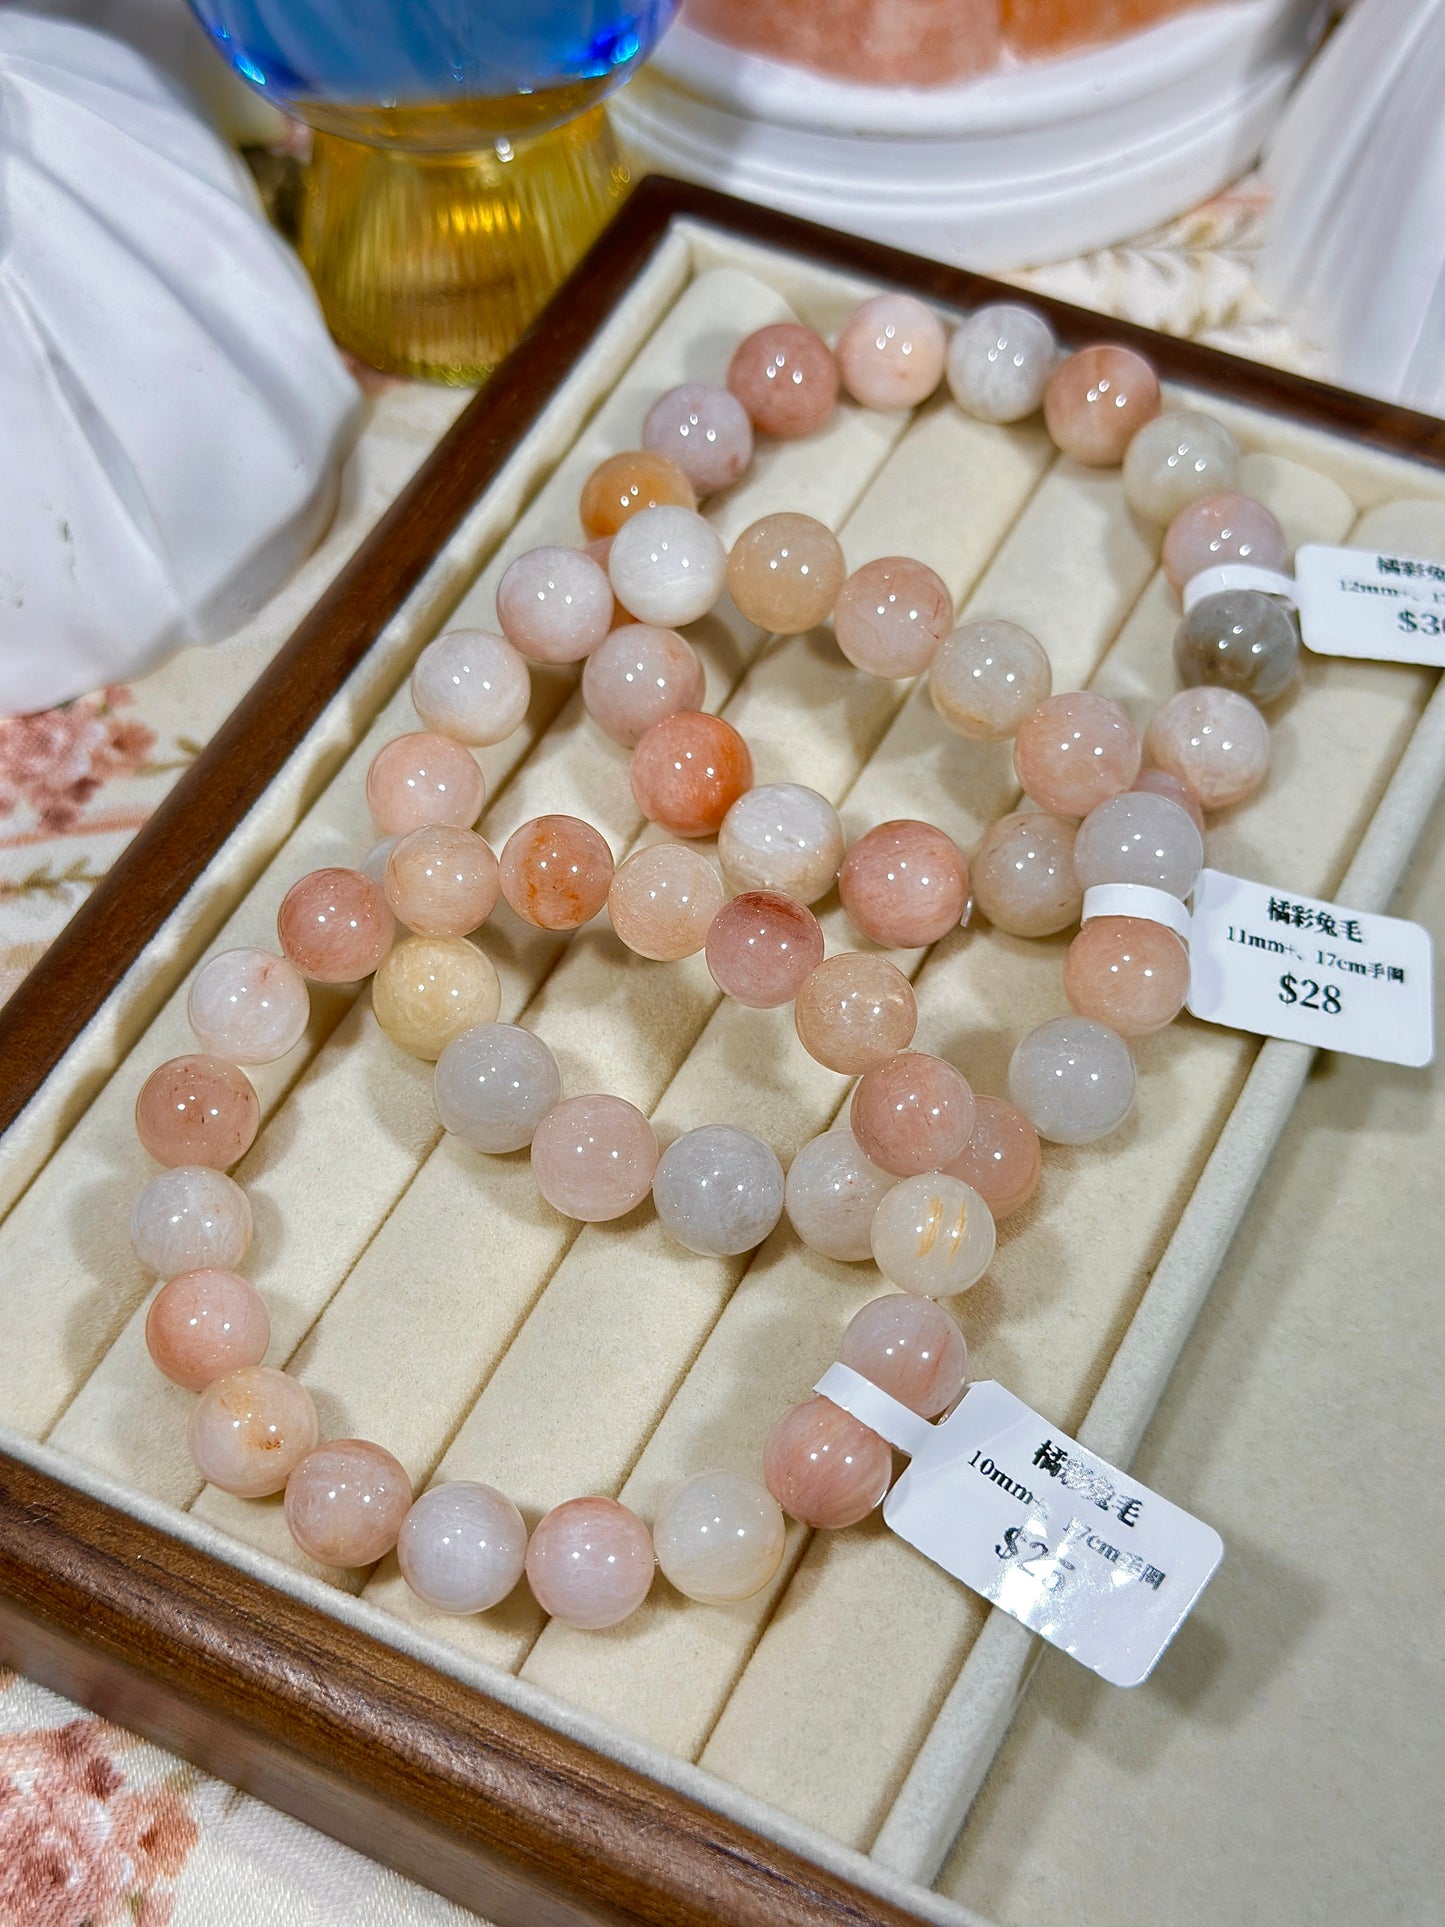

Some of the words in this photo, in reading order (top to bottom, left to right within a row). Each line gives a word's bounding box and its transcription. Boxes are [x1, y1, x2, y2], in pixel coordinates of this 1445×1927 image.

[1398, 608, 1445, 635] $3
[1267, 896, 1363, 943] 橘彩兔毛
[1278, 971, 1342, 1014] $28
